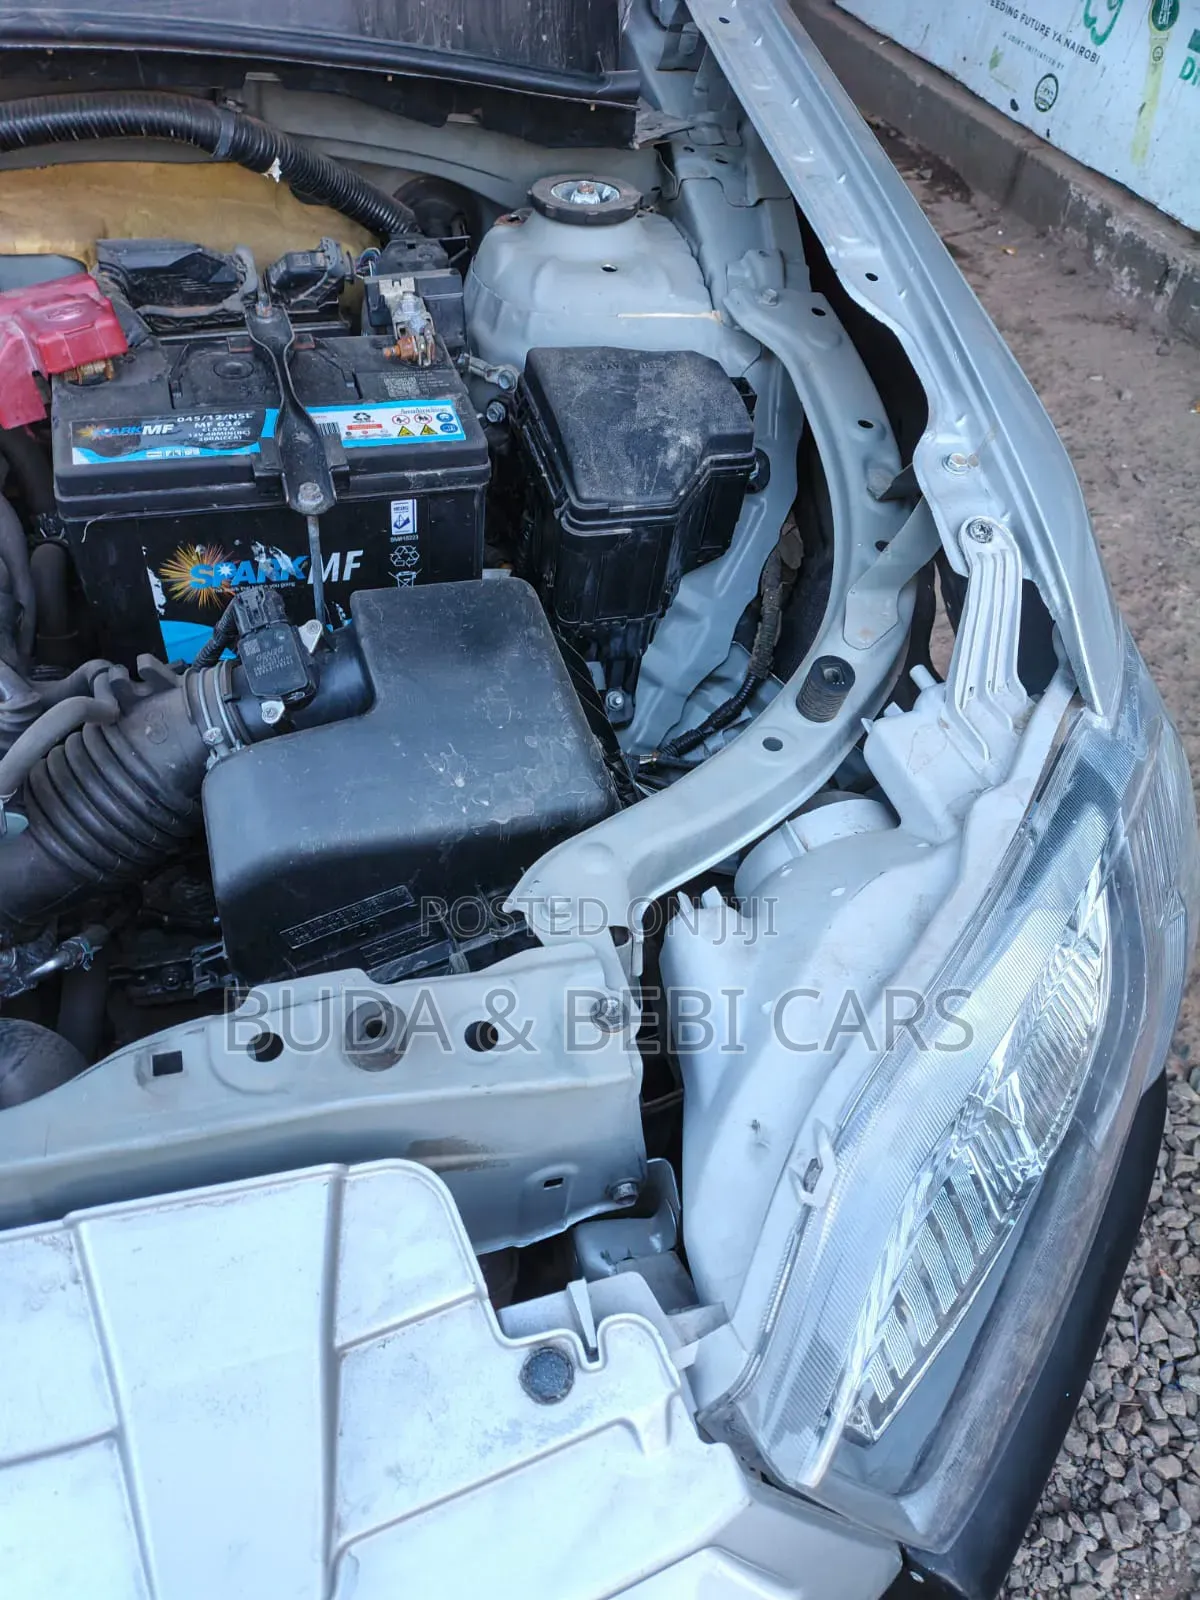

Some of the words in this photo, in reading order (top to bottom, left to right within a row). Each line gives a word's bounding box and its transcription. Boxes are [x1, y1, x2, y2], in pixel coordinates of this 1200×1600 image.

[1158, 11, 1172, 25] EAT
[987, 0, 1019, 19] EEDING
[1020, 13, 1050, 37] FUTURE
[1052, 30, 1062, 43] YA
[1063, 39, 1101, 64] NAIROBI
[194, 421, 213, 429] MF
